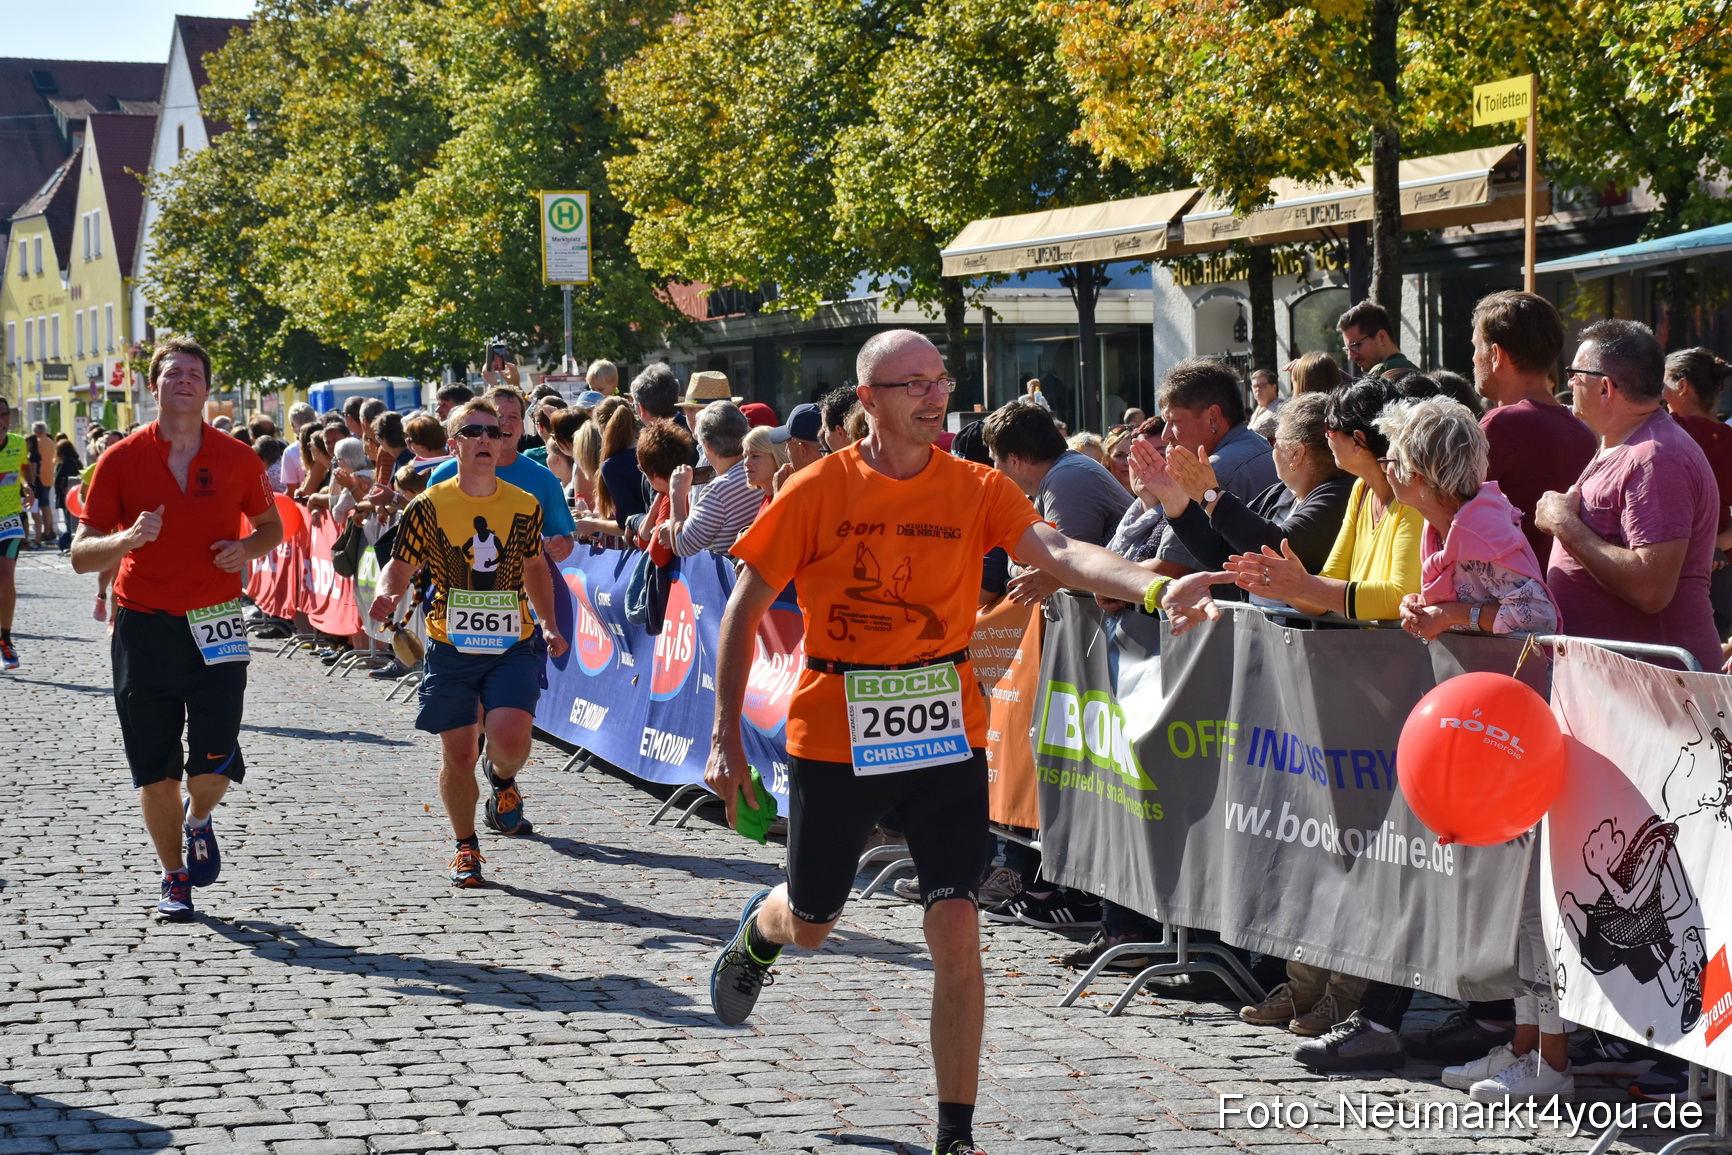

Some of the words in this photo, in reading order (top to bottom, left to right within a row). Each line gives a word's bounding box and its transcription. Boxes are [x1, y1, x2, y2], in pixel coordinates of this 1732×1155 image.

[1484, 91, 1527, 112] Toiletten
[557, 205, 574, 225] H
[896, 525, 915, 536] DER
[917, 529, 941, 538] NEUE
[942, 528, 962, 539] TAG
[905, 523, 953, 532] MEDIENHAUS
[453, 592, 514, 608] BOCK
[456, 611, 512, 632] 2661
[827, 604, 857, 642] 5.
[464, 637, 503, 647] ANDRÉ
[987, 626, 1022, 640] Partner
[974, 645, 992, 658] und
[854, 667, 953, 698] BOCK
[862, 700, 950, 738] 2609
[863, 740, 958, 763] CHRISTIAN
[1483, 737, 1522, 760] energie
[1247, 727, 1397, 791] INDUSTRY
[1036, 759, 1094, 794] inspired
[1096, 768, 1104, 802] by
[932, 887, 954, 901] cep
[795, 908, 814, 921] cep
